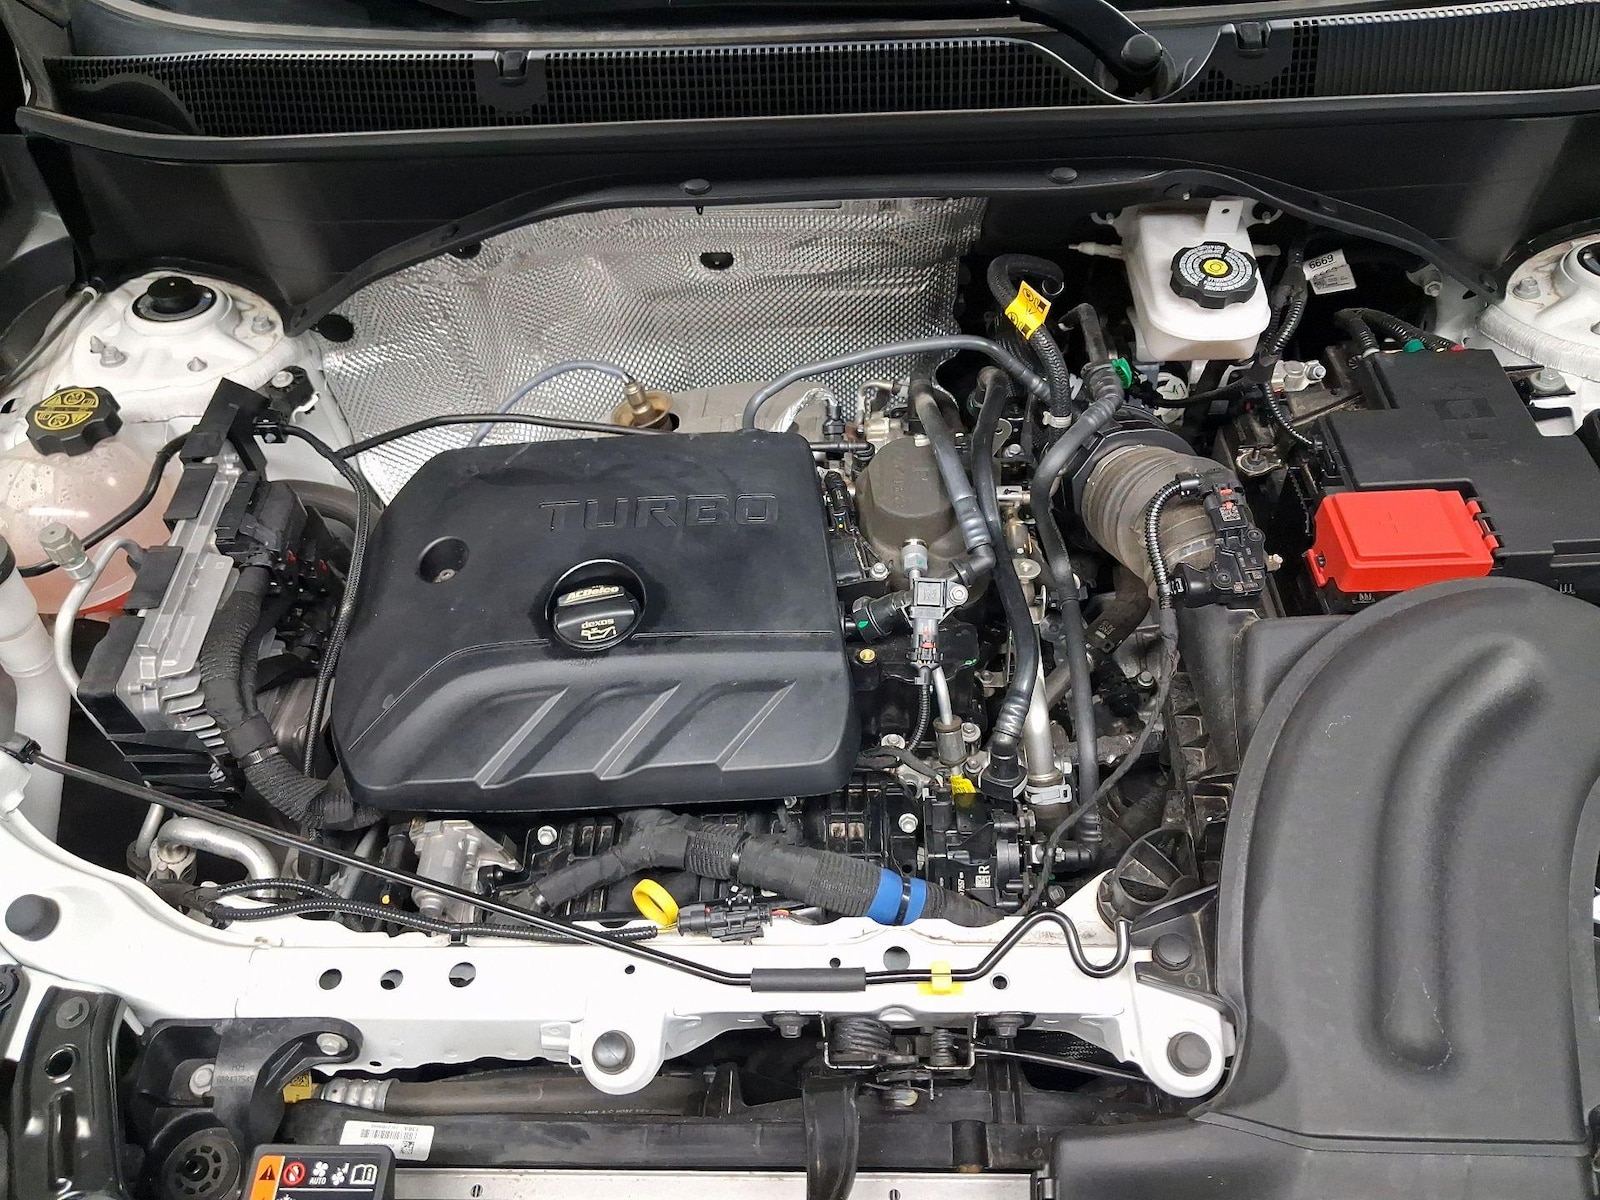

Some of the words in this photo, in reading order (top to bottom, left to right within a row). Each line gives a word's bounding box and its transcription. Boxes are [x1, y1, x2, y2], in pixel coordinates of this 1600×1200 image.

[1308, 253, 1335, 270] 6669
[538, 492, 779, 532] TURBO
[564, 586, 620, 604] ACDelco
[581, 618, 615, 629] dexos
[309, 1176, 327, 1186] AUTO
